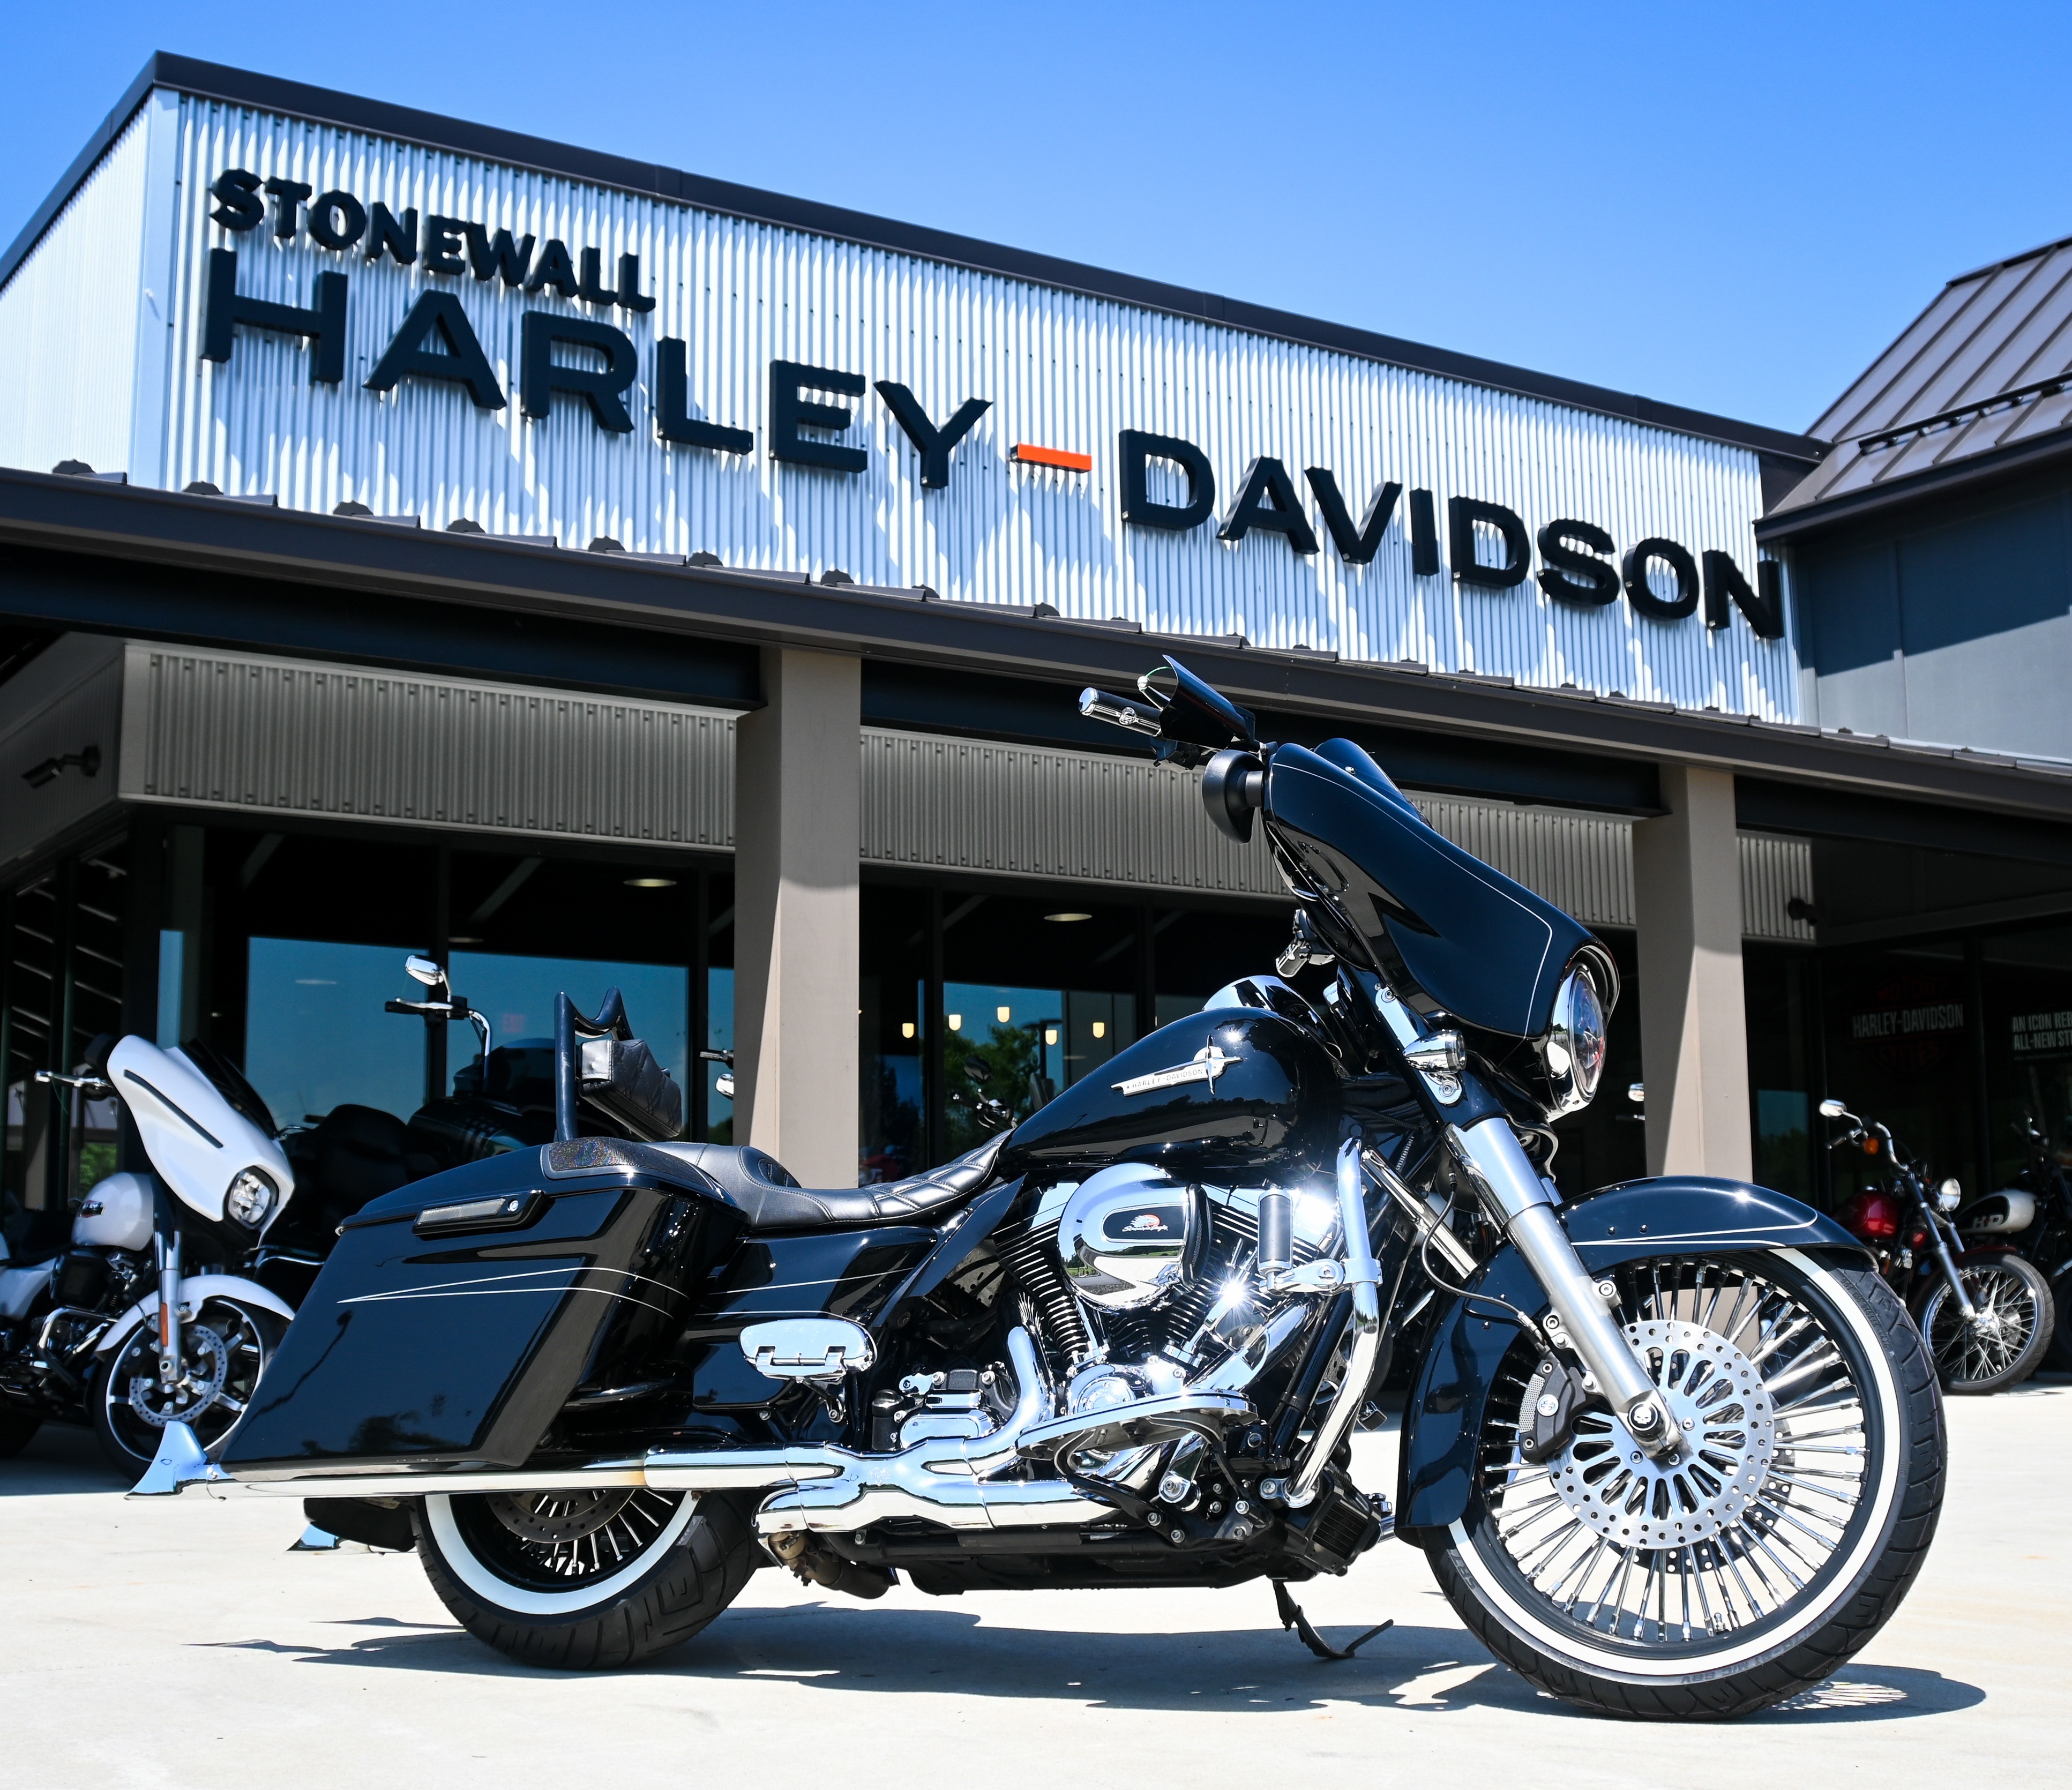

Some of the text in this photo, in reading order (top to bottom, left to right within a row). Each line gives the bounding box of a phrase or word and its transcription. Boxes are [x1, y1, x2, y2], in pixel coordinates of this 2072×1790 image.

[210, 168, 656, 313] STONEWALL
[1852, 1003, 1964, 1039] HARLEY-DAVIDSON
[2013, 1016, 2026, 1032] AN
[2029, 1014, 2052, 1031] ICON
[2014, 1031, 2056, 1051] ALL-NEW
[1132, 1069, 1203, 1089] HARLEY-DAVIDSON
[1840, 1277, 1853, 1291] DOT
